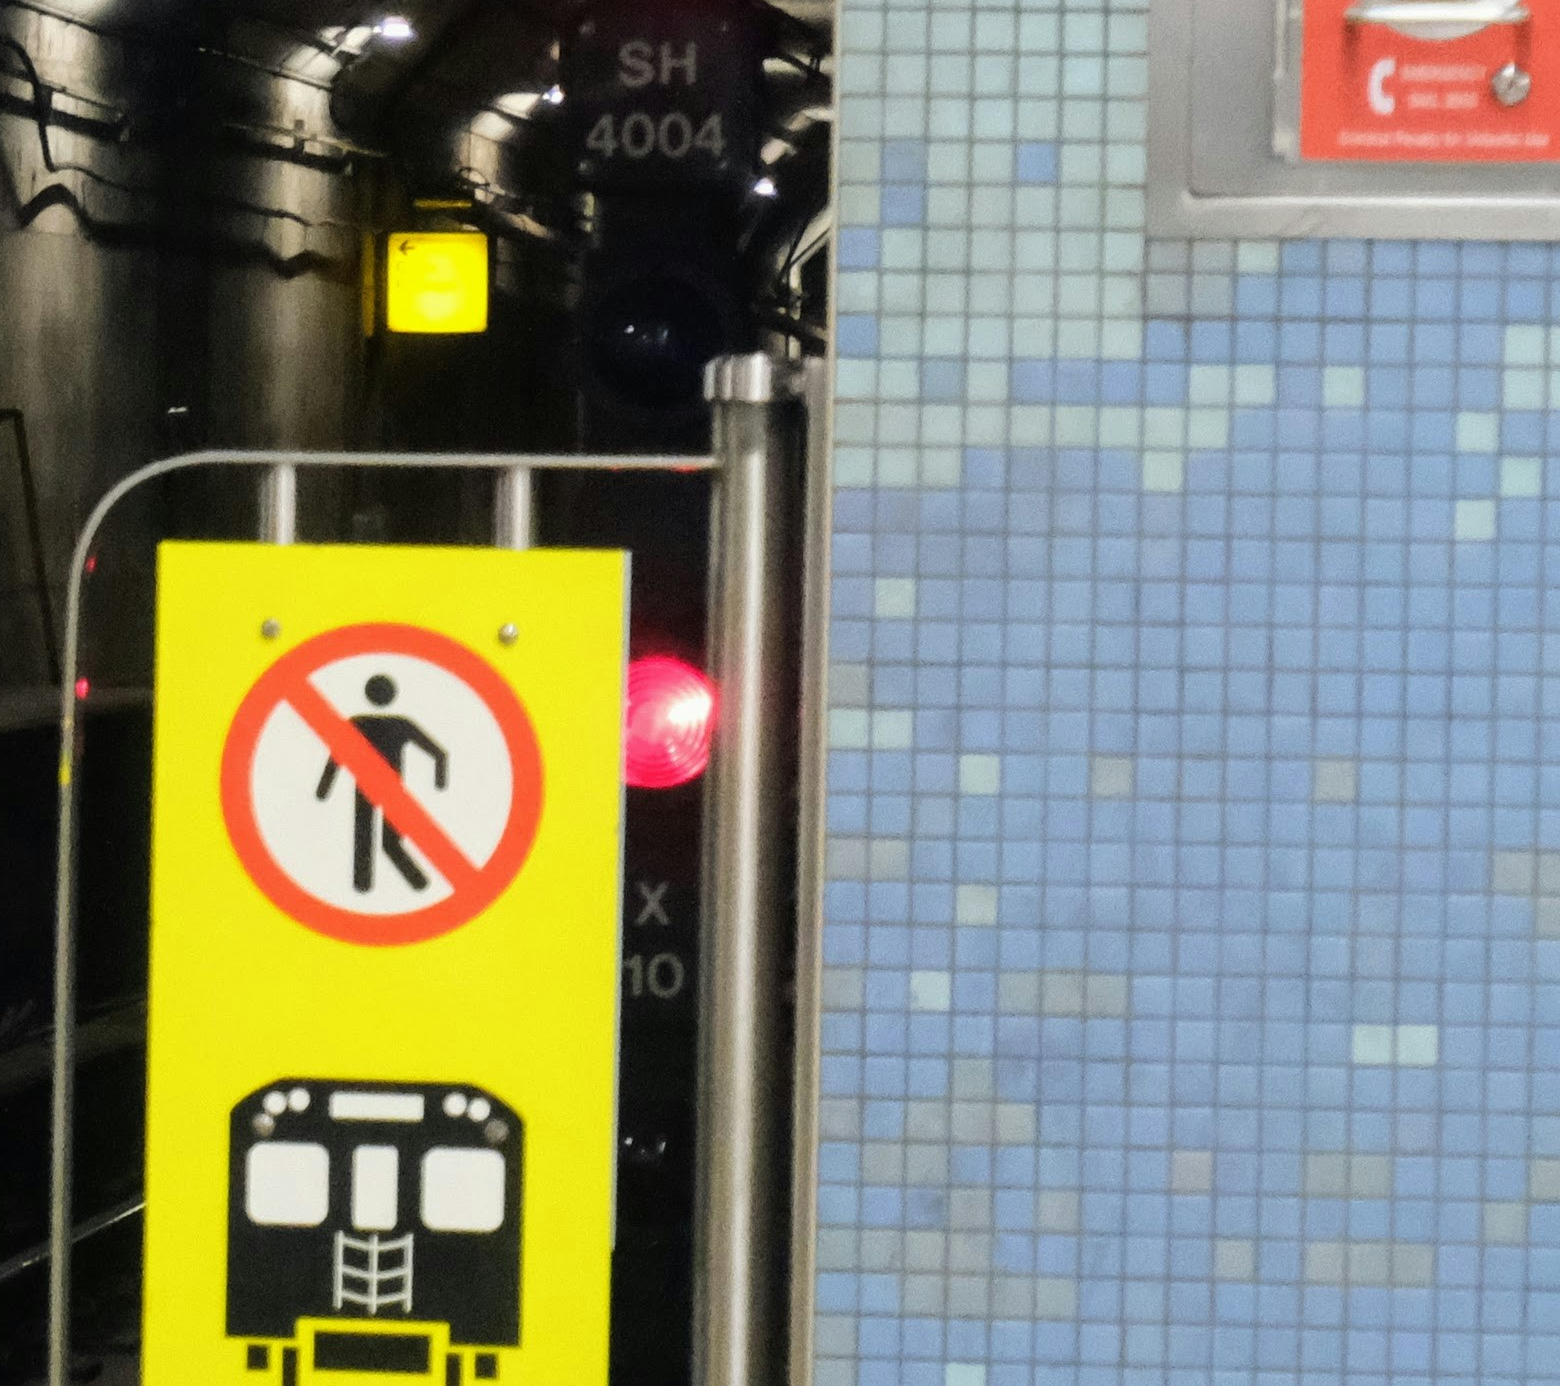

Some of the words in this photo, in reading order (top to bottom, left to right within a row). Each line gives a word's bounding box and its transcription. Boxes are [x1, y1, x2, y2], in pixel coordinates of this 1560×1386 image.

[619, 40, 697, 88] SH
[586, 113, 726, 158] 4004
[635, 881, 670, 926] X
